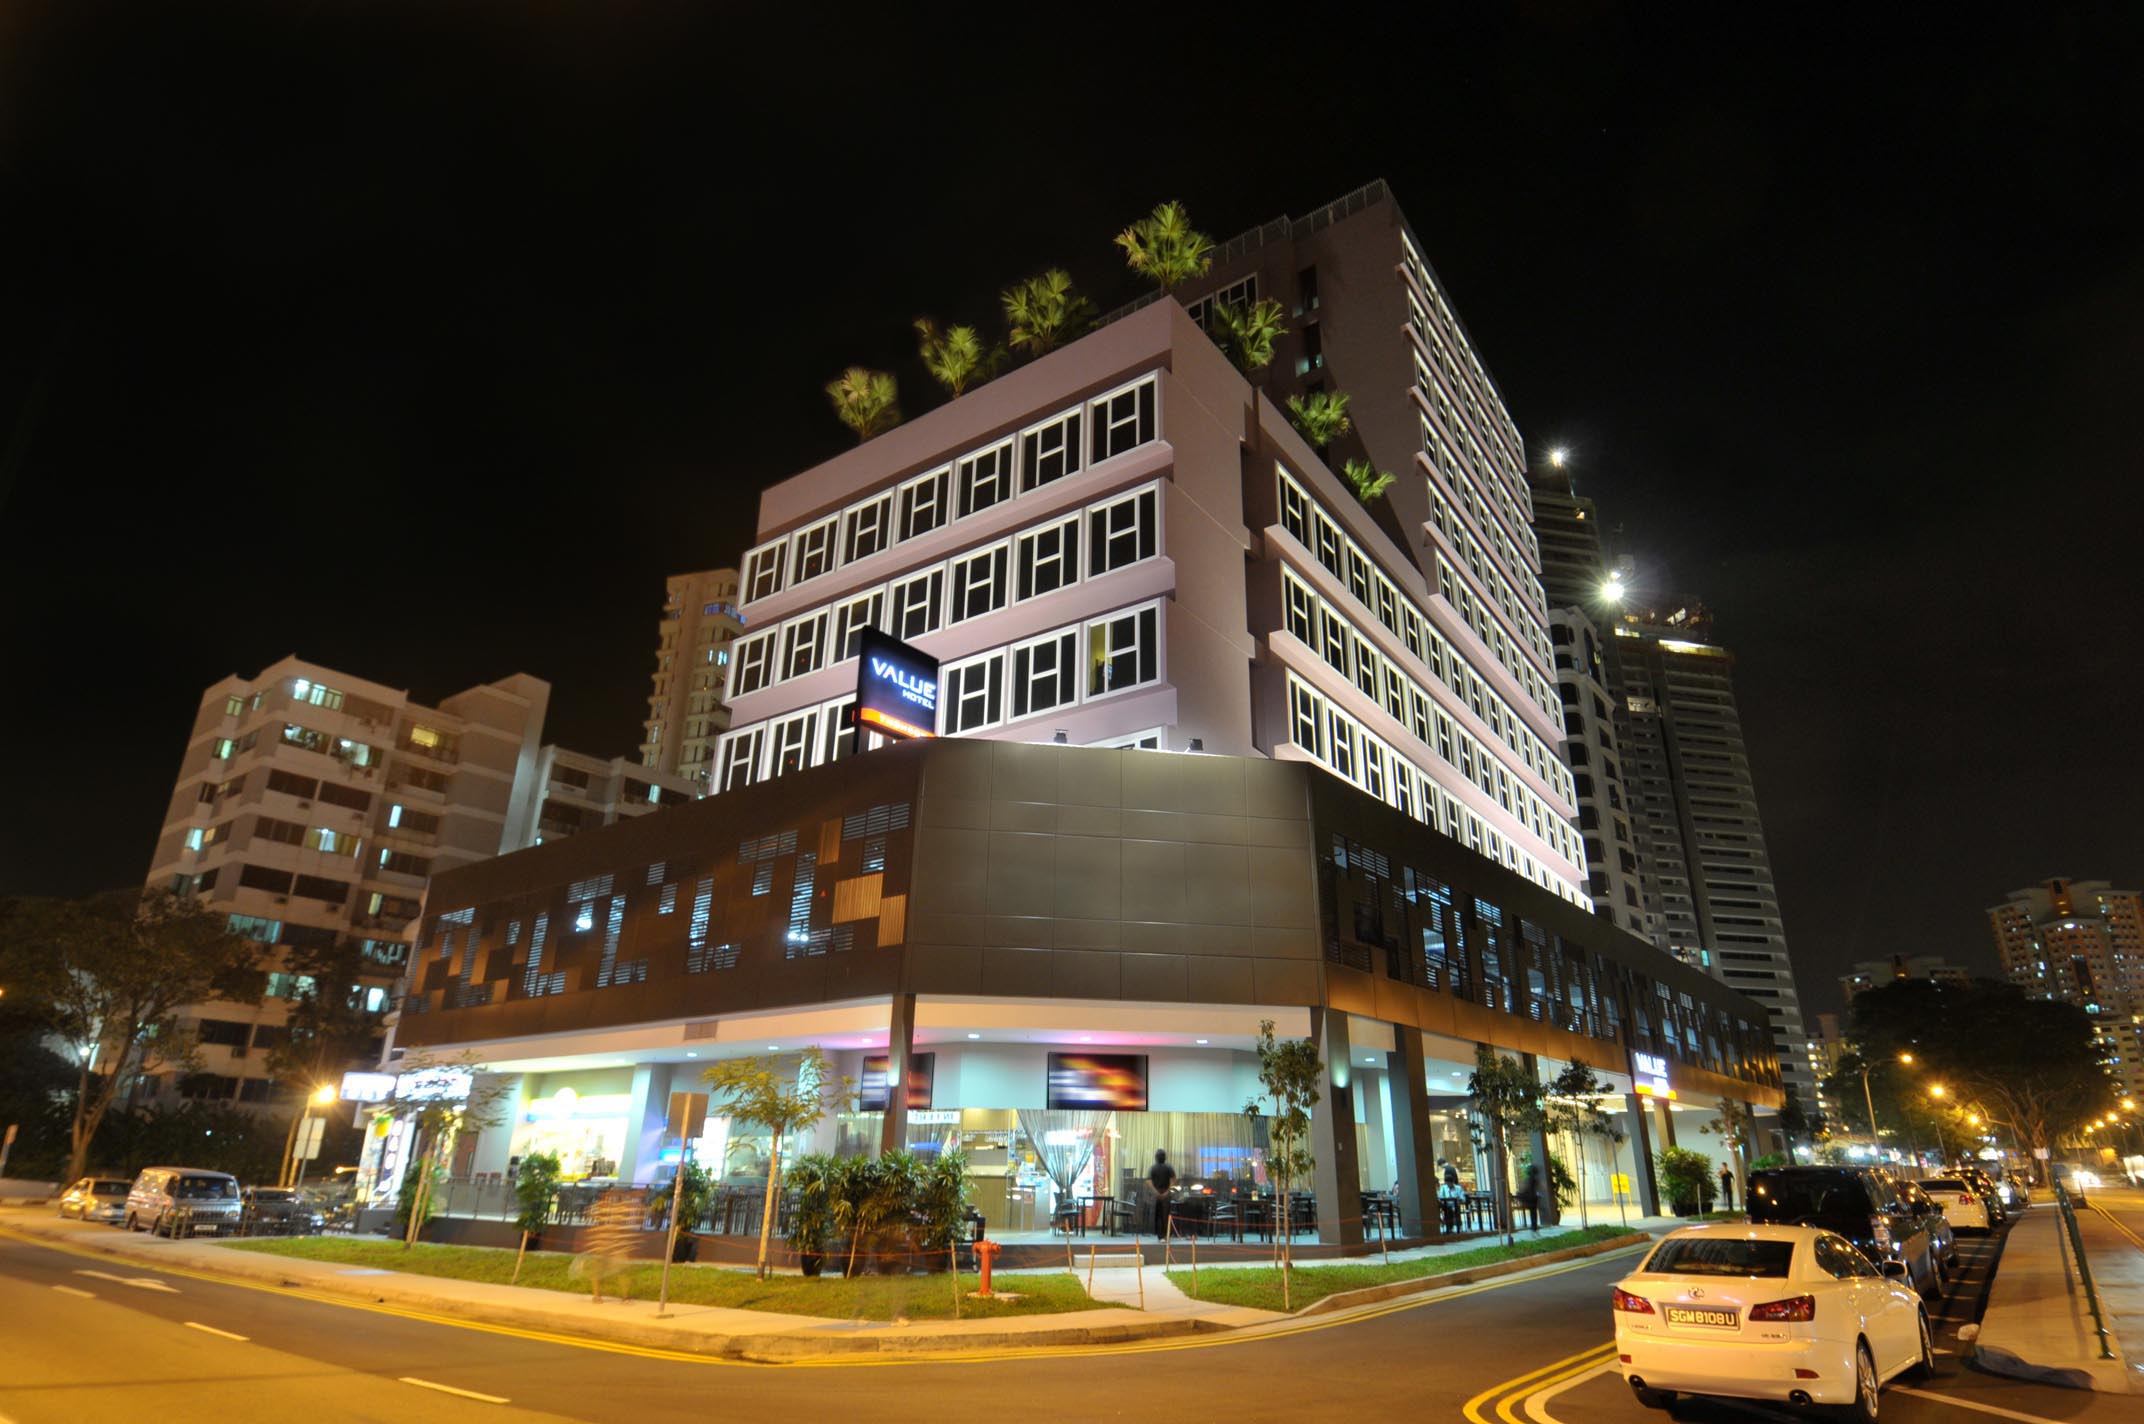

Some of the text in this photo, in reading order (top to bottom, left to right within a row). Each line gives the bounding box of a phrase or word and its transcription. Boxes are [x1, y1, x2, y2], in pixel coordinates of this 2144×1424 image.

[872, 657, 936, 700] VALUE
[902, 689, 935, 710] HOTEL
[1635, 1052, 1668, 1078] VALUE
